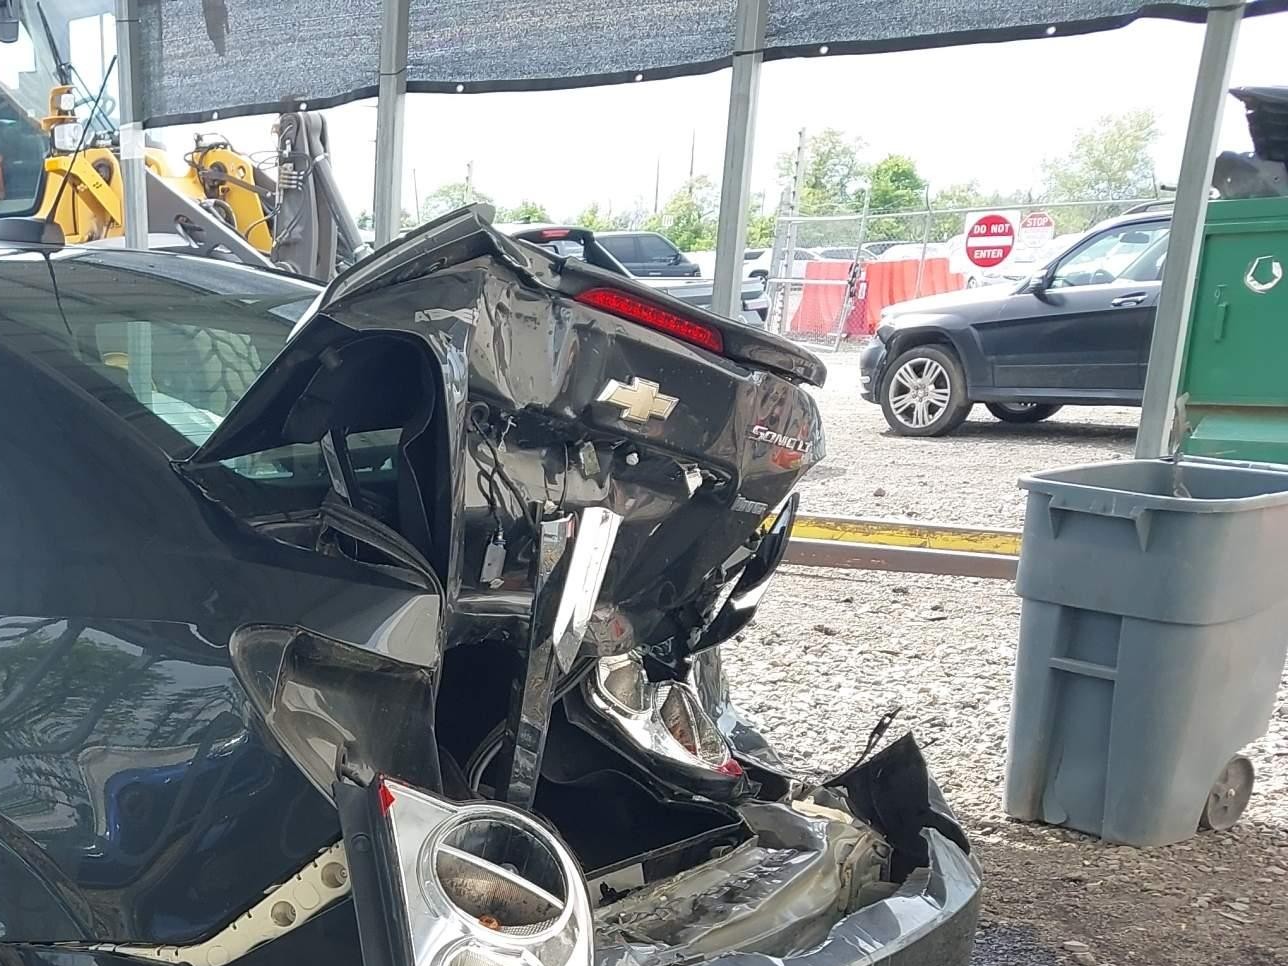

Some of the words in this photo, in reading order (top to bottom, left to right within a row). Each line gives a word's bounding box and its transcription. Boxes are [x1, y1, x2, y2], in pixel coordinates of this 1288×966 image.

[1027, 217, 1048, 227] STOP
[974, 225, 987, 234] DO
[990, 223, 1010, 233] NOT
[974, 249, 1003, 259] ENTER
